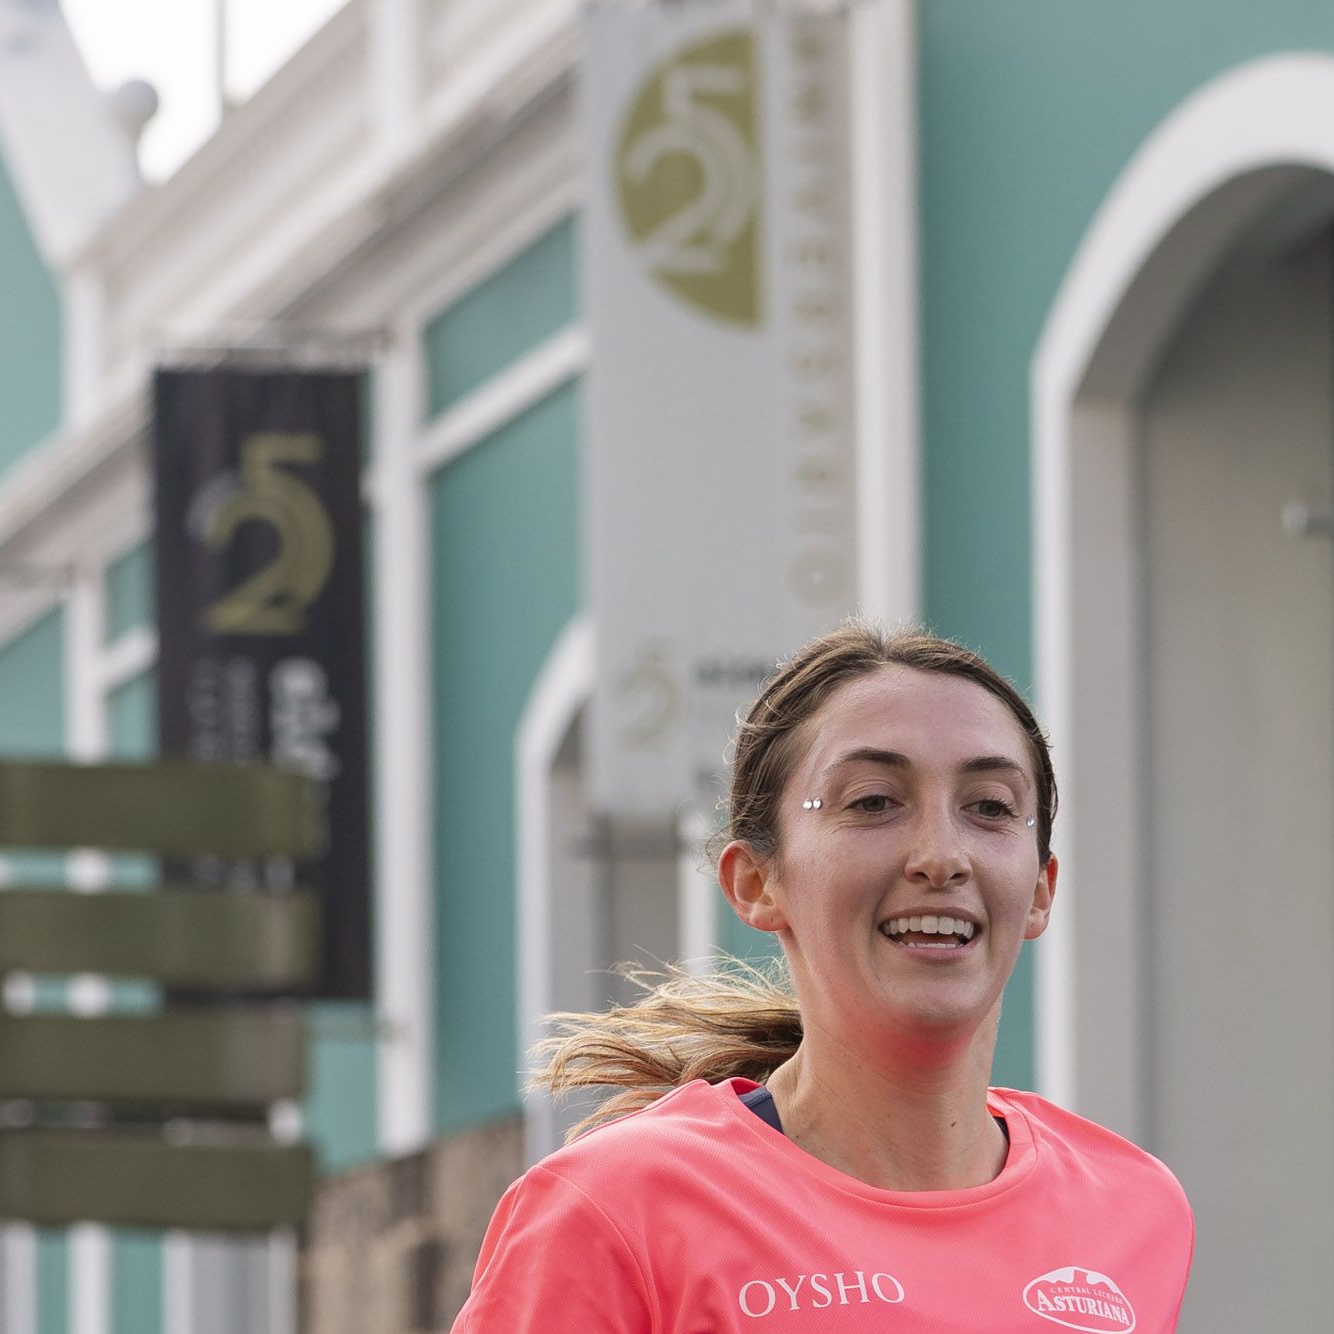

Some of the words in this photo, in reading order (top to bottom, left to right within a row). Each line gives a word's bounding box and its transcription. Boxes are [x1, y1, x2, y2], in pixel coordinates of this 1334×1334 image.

[738, 1270, 906, 1318] OYSHO
[1037, 1289, 1132, 1327] ASTURIANA
[1050, 1286, 1092, 1295] CENTRAL
